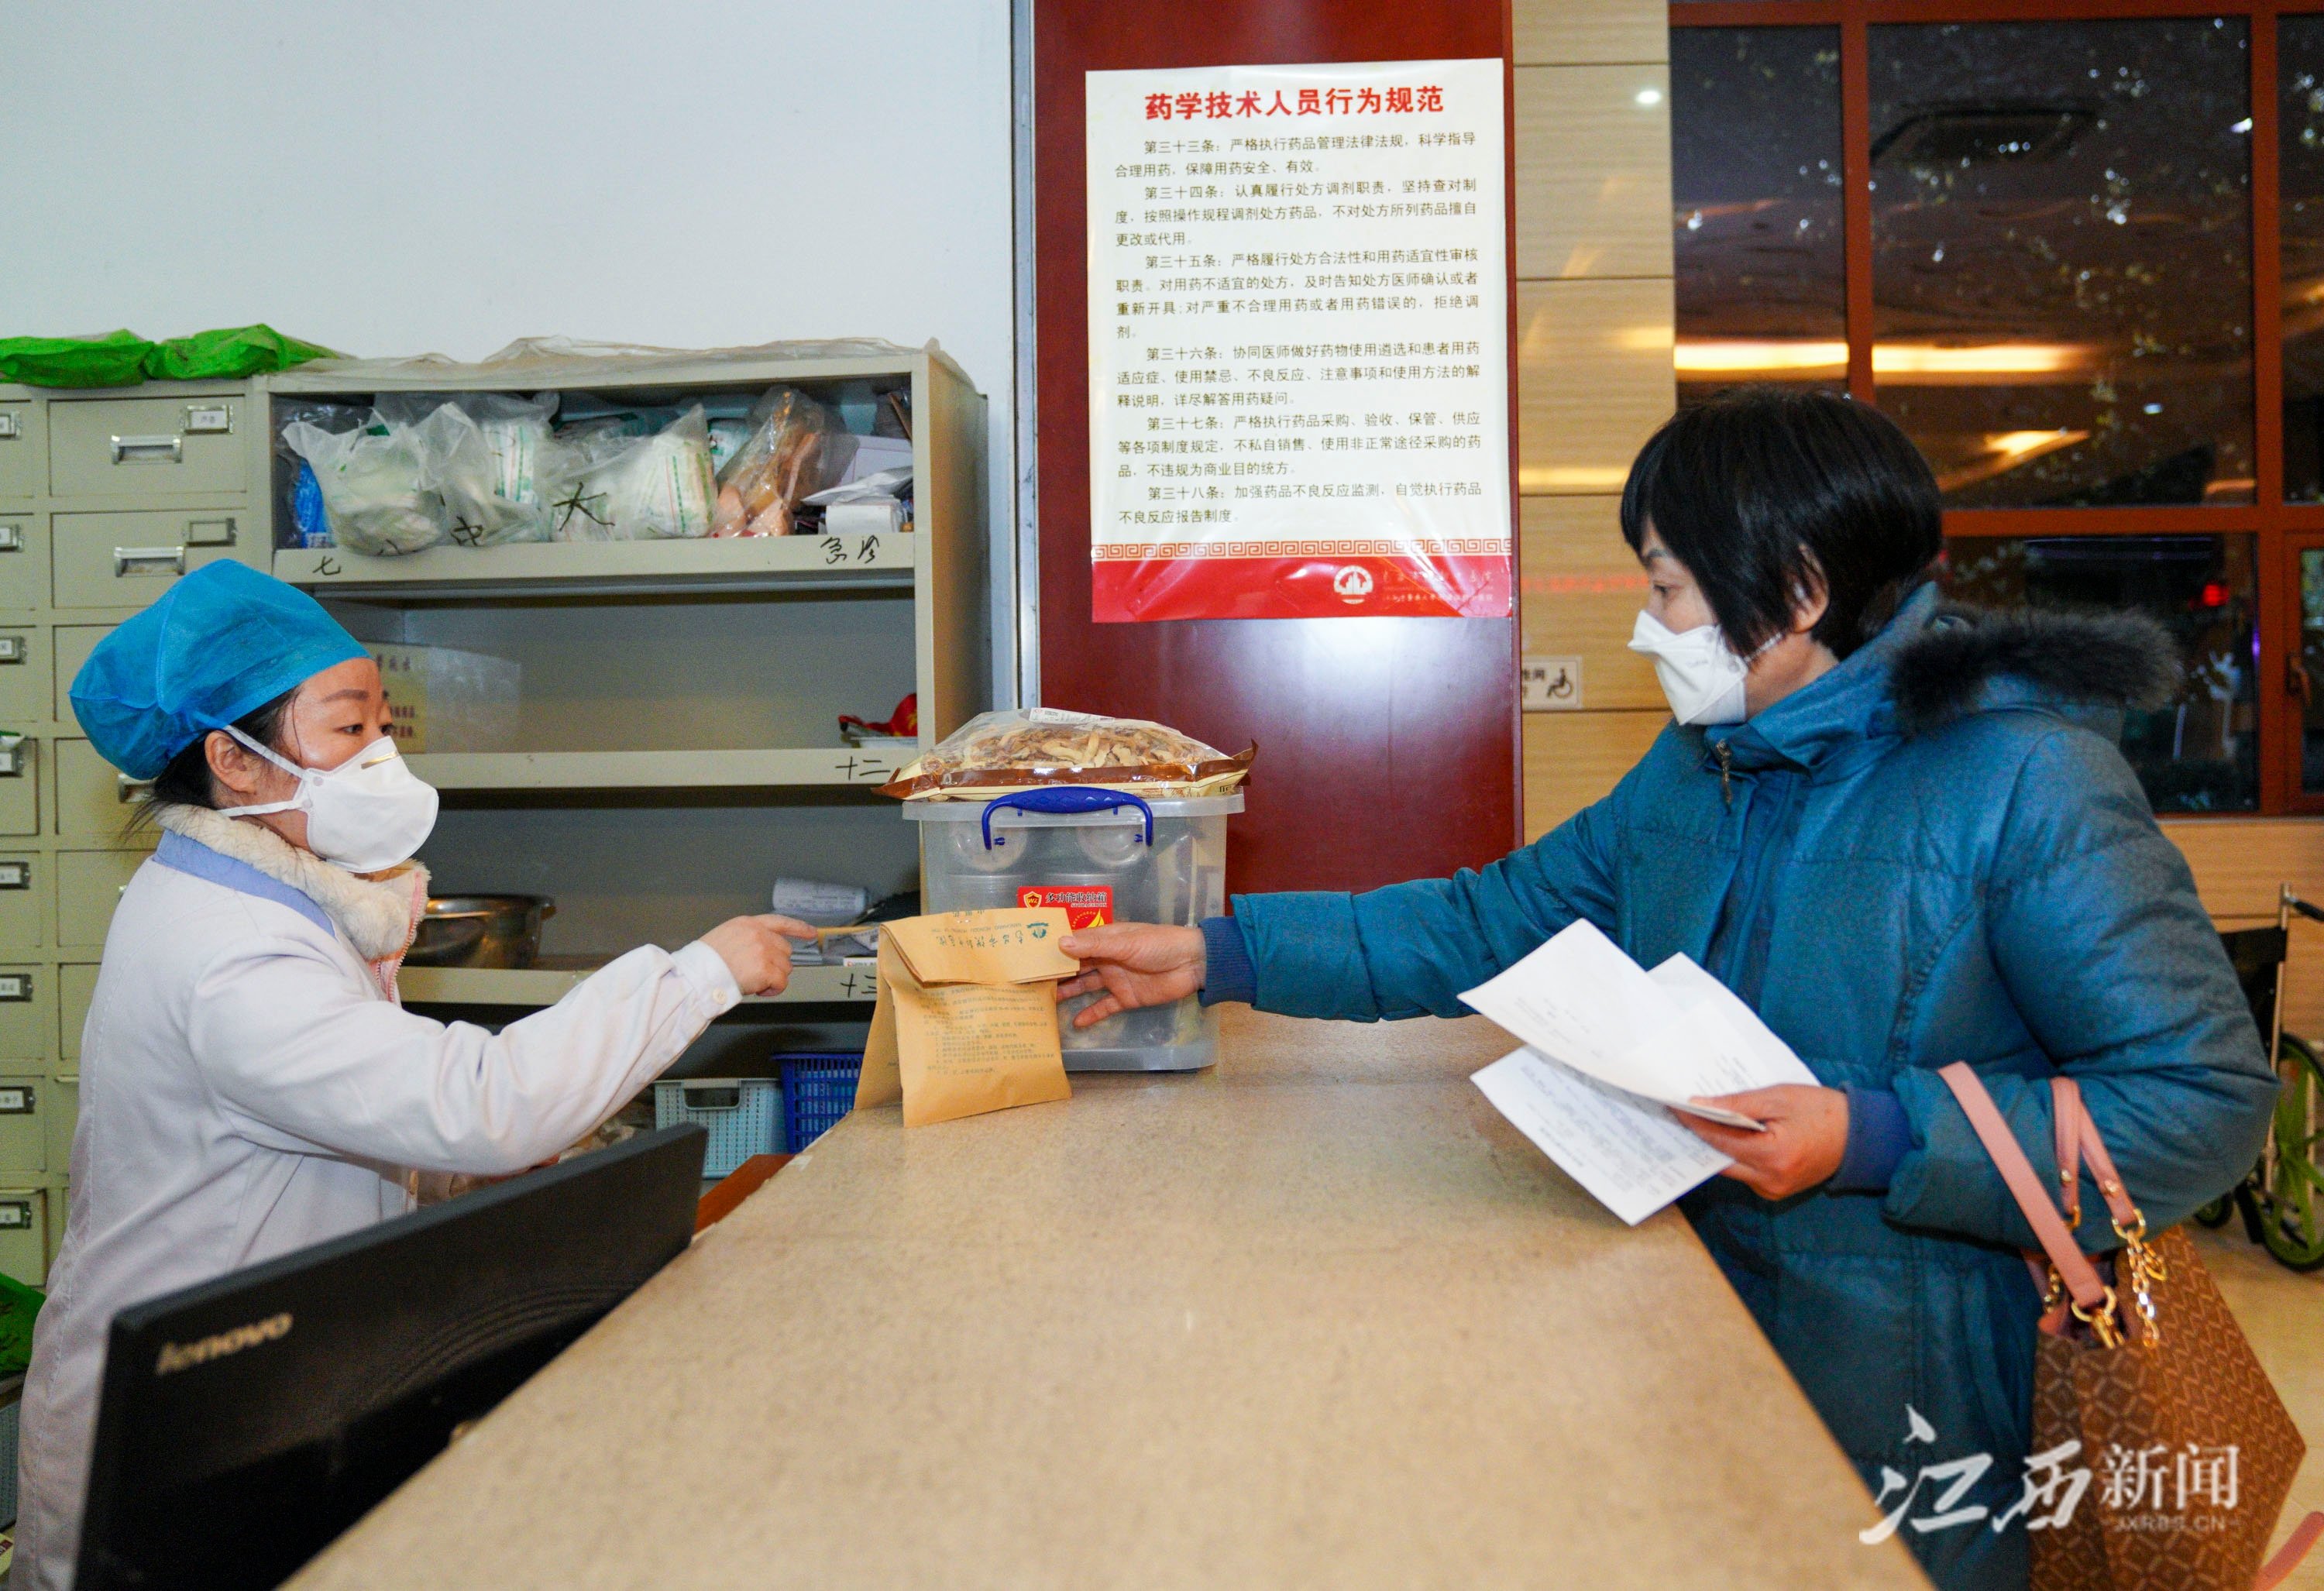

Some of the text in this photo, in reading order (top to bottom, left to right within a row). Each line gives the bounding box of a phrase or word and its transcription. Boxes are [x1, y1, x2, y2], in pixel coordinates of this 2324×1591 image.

[1145, 85, 1445, 121] 药学技术人员行为规范
[1116, 232, 1192, 247] 更改或代用。
[552, 482, 615, 531] 大
[312, 555, 342, 576] 七
[834, 756, 891, 781] 十二
[1045, 892, 1108, 904] 多功能收纳箱
[156, 1312, 294, 1376] lenovo
